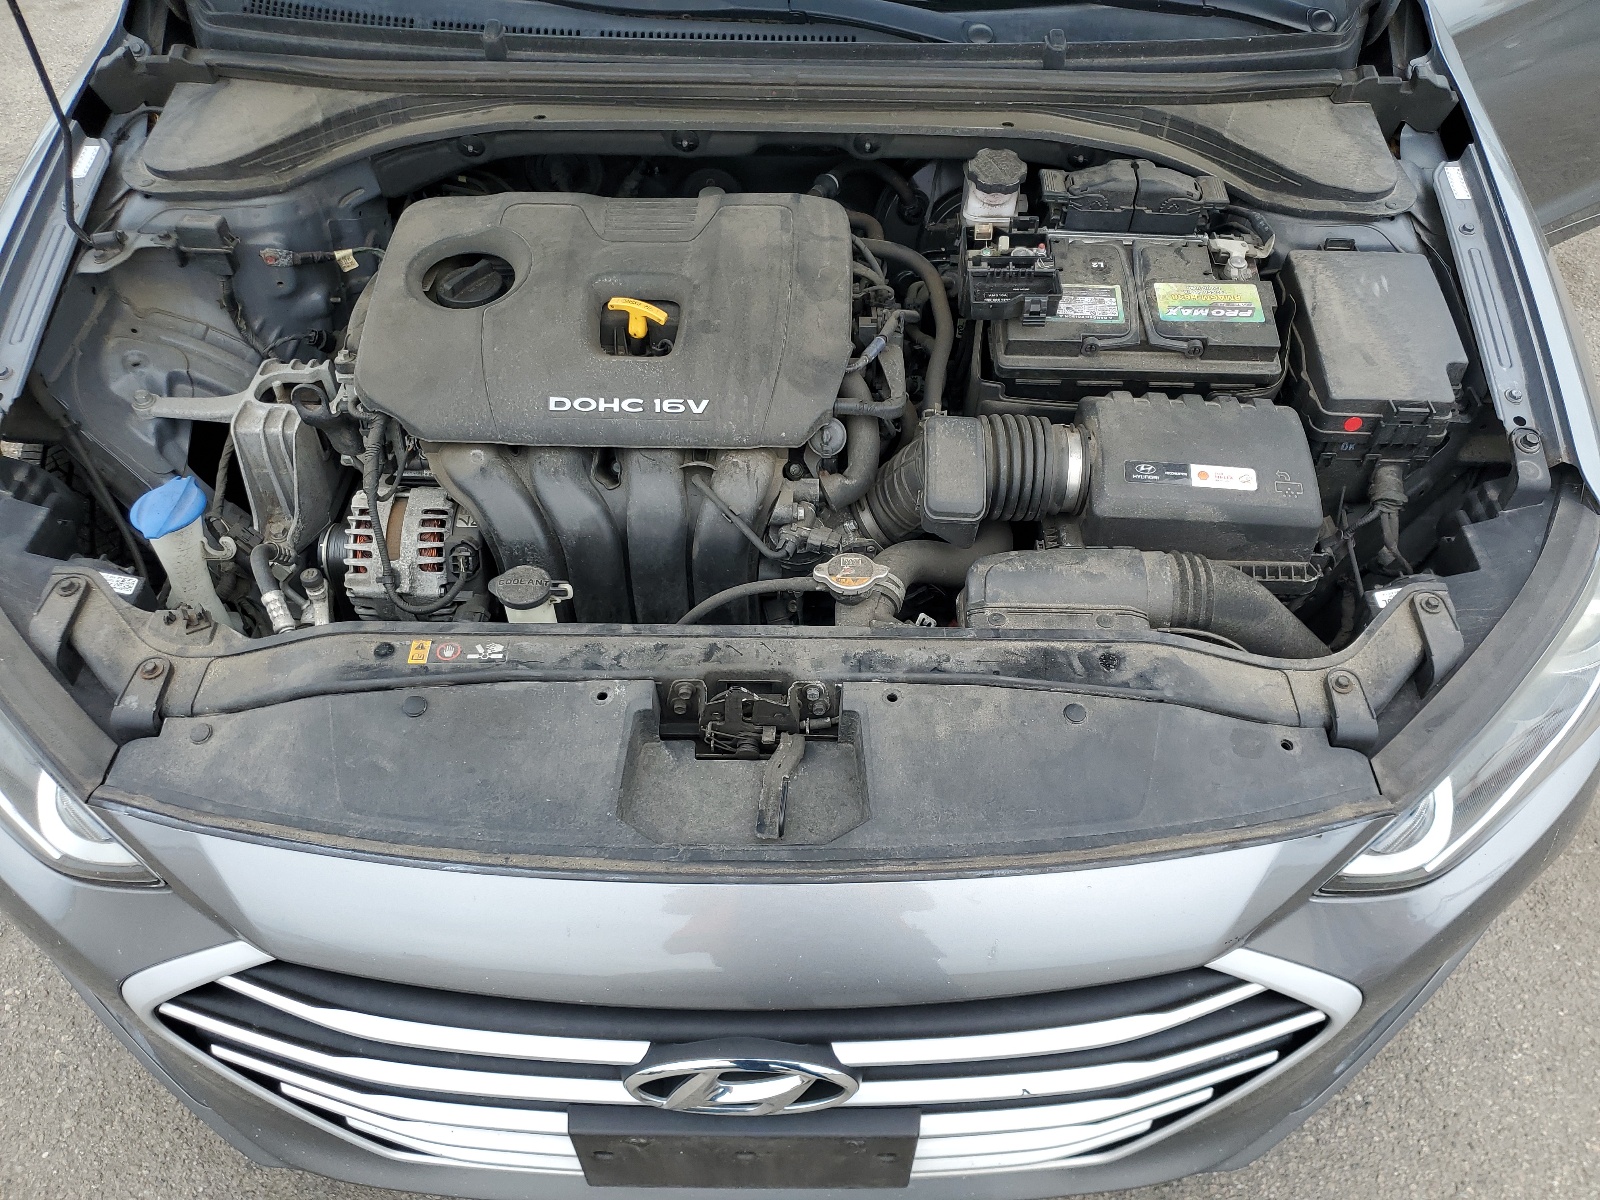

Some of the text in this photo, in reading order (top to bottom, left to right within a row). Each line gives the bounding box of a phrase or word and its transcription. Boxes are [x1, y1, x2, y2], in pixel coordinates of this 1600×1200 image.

[548, 396, 710, 415] DOHC 16V
[498, 577, 550, 587] COOLANT
